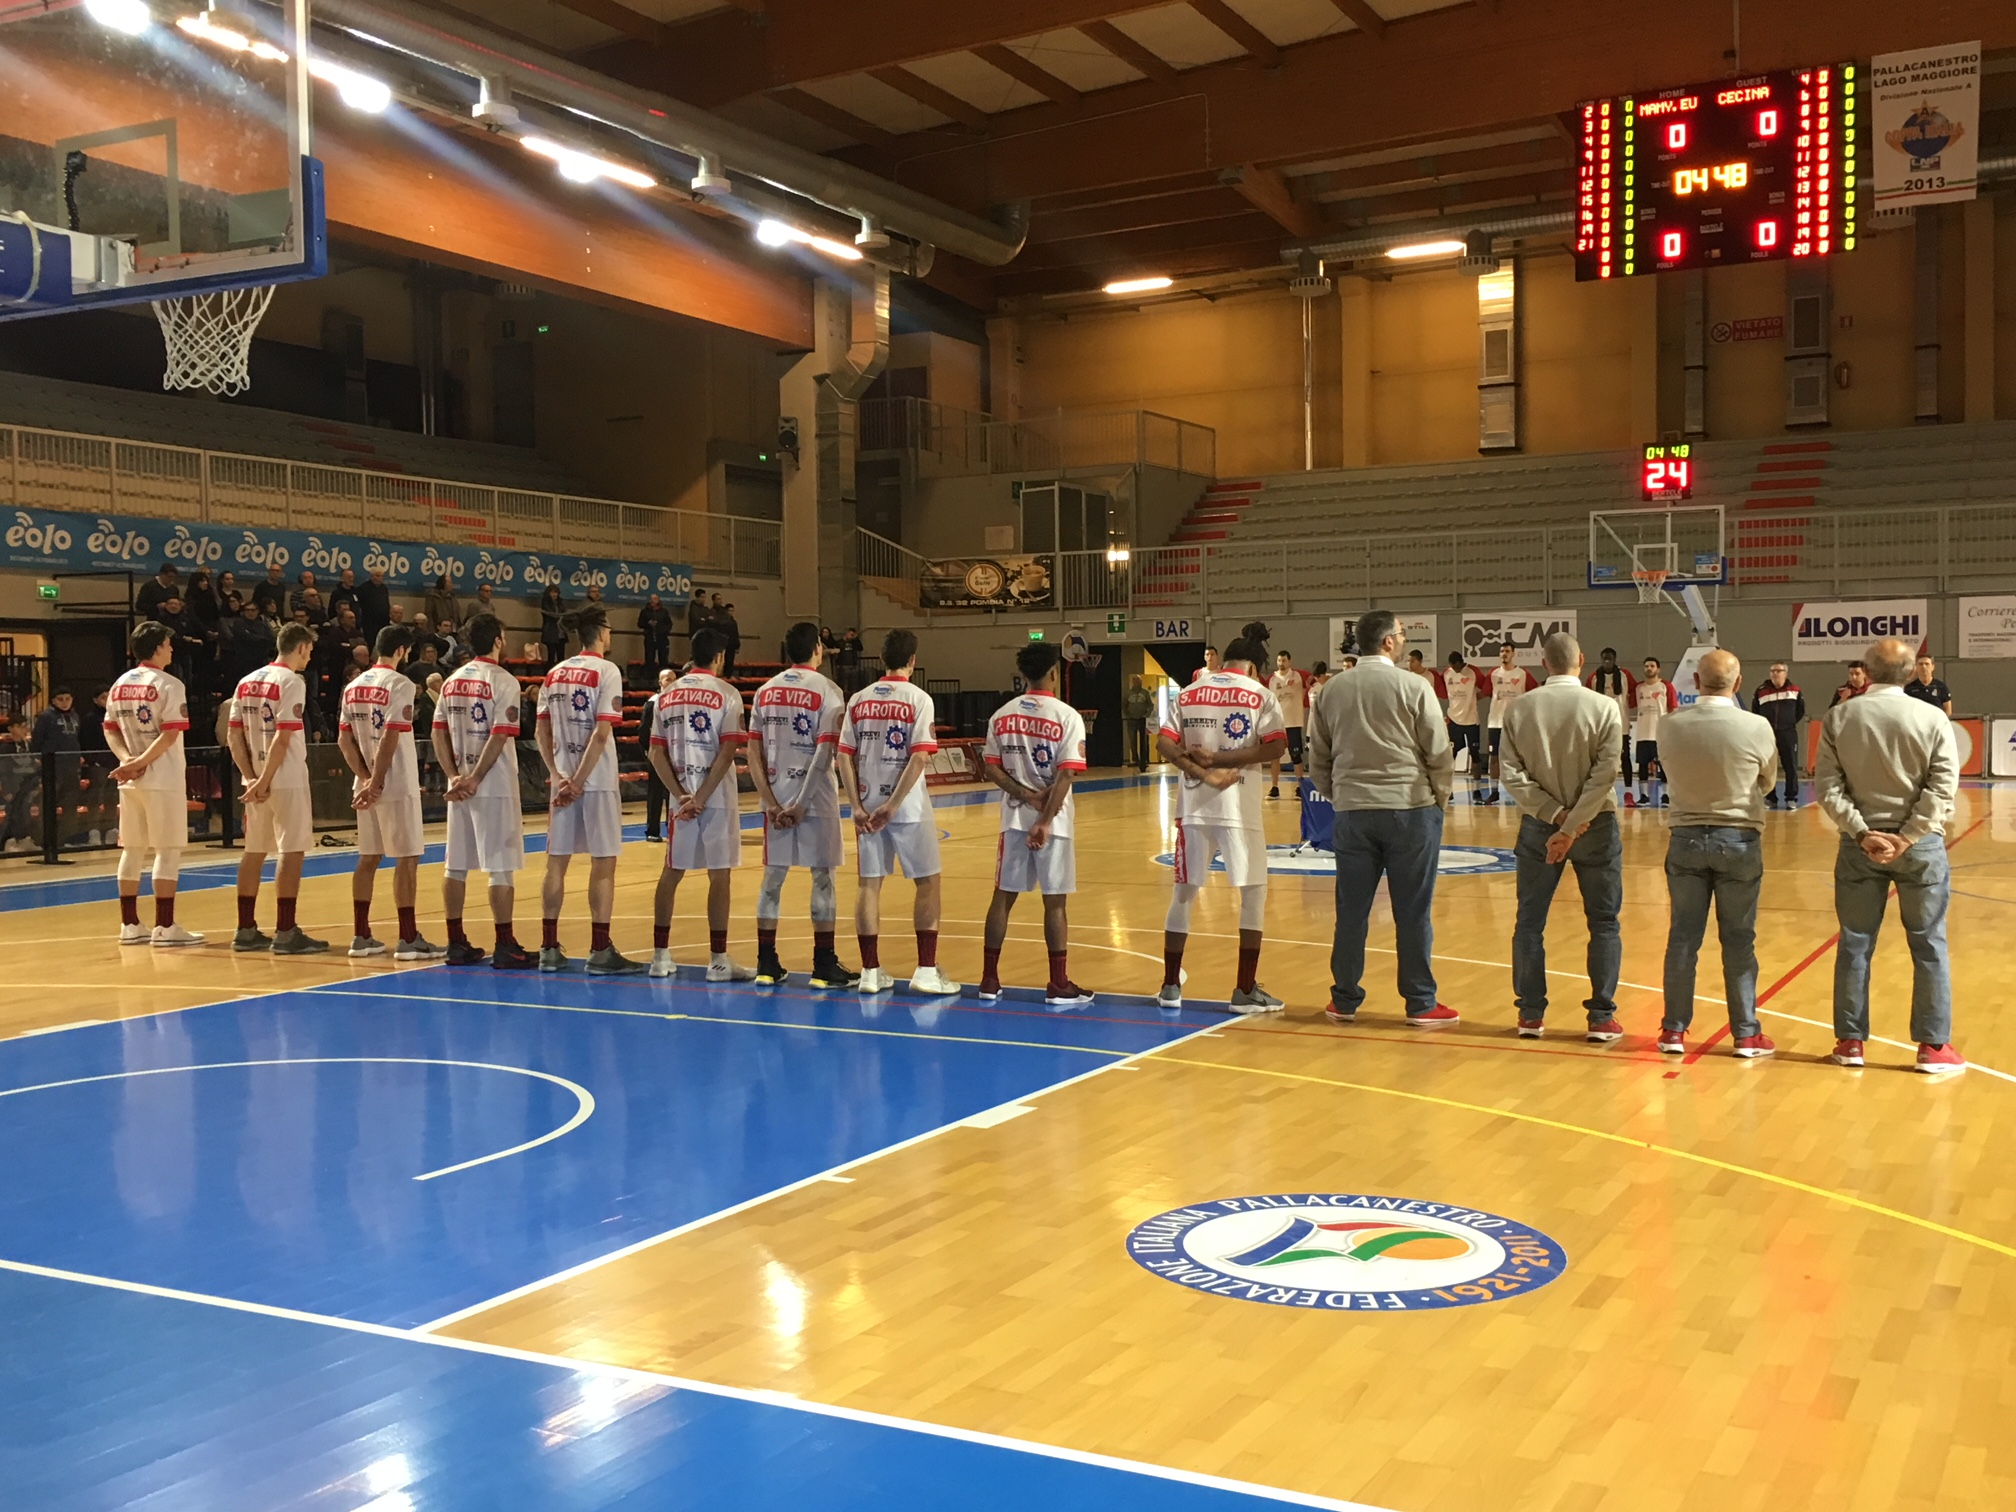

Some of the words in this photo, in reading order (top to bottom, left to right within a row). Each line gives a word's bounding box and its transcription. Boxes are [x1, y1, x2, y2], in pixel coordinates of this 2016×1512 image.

[1873, 54, 1978, 77] PALLACANESTRO
[1736, 76, 1768, 88] GUEST
[1801, 73, 1810, 85] 4
[1845, 67, 1855, 80] 0
[1874, 75, 1907, 89] LAGO
[1911, 65, 1978, 83] MAGGIORE
[1659, 89, 1685, 99] HOME
[1717, 86, 1770, 105] CECINA
[1801, 90, 1810, 101] 6
[1845, 82, 1855, 95] 0
[1921, 84, 1963, 96] Nazionale
[1586, 106, 1593, 118] 2
[1625, 101, 1634, 113] 0
[1801, 104, 1810, 117] 8
[1845, 98, 1855, 111] 0
[1586, 121, 1593, 132] 3
[1625, 115, 1634, 127] 0
[1759, 110, 1777, 136] 0
[1801, 119, 1810, 131] 9
[1845, 114, 1855, 127] 0
[1586, 136, 1593, 146] 4
[1625, 130, 1634, 142] 0
[1669, 123, 1686, 149] 0
[1797, 135, 1810, 148] 10
[1586, 150, 1593, 161] 9
[1625, 145, 1634, 157] 0
[1797, 151, 1810, 162] 11
[1845, 145, 1855, 158] 0
[1582, 165, 1593, 176] 11
[1625, 160, 1634, 172] 0
[1797, 165, 1810, 178] 12
[1845, 160, 1855, 173] 0
[1911, 157, 1939, 168] LNP
[1582, 180, 1593, 191] 12
[1625, 175, 1634, 187] 0
[1797, 181, 1810, 194] 13
[1845, 176, 1855, 189] 0
[1904, 176, 1946, 192] 2013
[1582, 195, 1593, 206] 15
[1625, 189, 1634, 201] 0
[1797, 197, 1810, 209] 14
[1845, 191, 1855, 204] 0
[1582, 210, 1593, 220] 16
[1625, 204, 1634, 216] 0
[1797, 211, 1810, 224] 18
[1845, 207, 1855, 220] 0
[1582, 224, 1593, 235] 19
[1625, 219, 1634, 231] 0
[1758, 221, 1776, 247] 0
[1797, 227, 1810, 239] 19
[1578, 239, 1594, 250] 21
[1625, 234, 1634, 246] 0
[1663, 232, 1681, 258] 0
[1793, 242, 1810, 256] 20
[1845, 238, 1855, 251] 0
[1625, 248, 1634, 260] 0
[1625, 263, 1634, 275] 0
[1734, 317, 1781, 329] VIETATO
[1734, 328, 1782, 341] FUMARE
[1646, 461, 1687, 489] 24
[6, 524, 72, 555] eolo
[87, 530, 150, 560] eolo
[164, 536, 222, 565] eolo
[235, 541, 290, 570] eolo
[301, 547, 352, 574] eolo
[363, 552, 411, 577] eolo
[420, 557, 464, 577] eolo
[474, 560, 514, 585] eolo
[524, 564, 562, 586] eolo
[570, 568, 608, 587] eolo
[616, 571, 650, 593] eolo
[656, 574, 691, 596] eolo
[1155, 620, 1189, 637] BAR
[1504, 621, 1569, 649] CMI
[552, 670, 591, 683] SPATTI
[764, 689, 782, 703] DE
[785, 689, 812, 707] VITA
[1180, 692, 1191, 704] S.
[1196, 688, 1260, 707] HIDALGO
[855, 703, 910, 719] MAROTTO
[1006, 716, 1061, 739] HIDALGO
[1218, 1194, 1508, 1229] PALLACANESTRO
[1133, 1208, 1220, 1253] ITALIANA
[1432, 1235, 1550, 1302] 1921-2011
[1145, 1257, 1407, 1310] FEDERAZIONE
